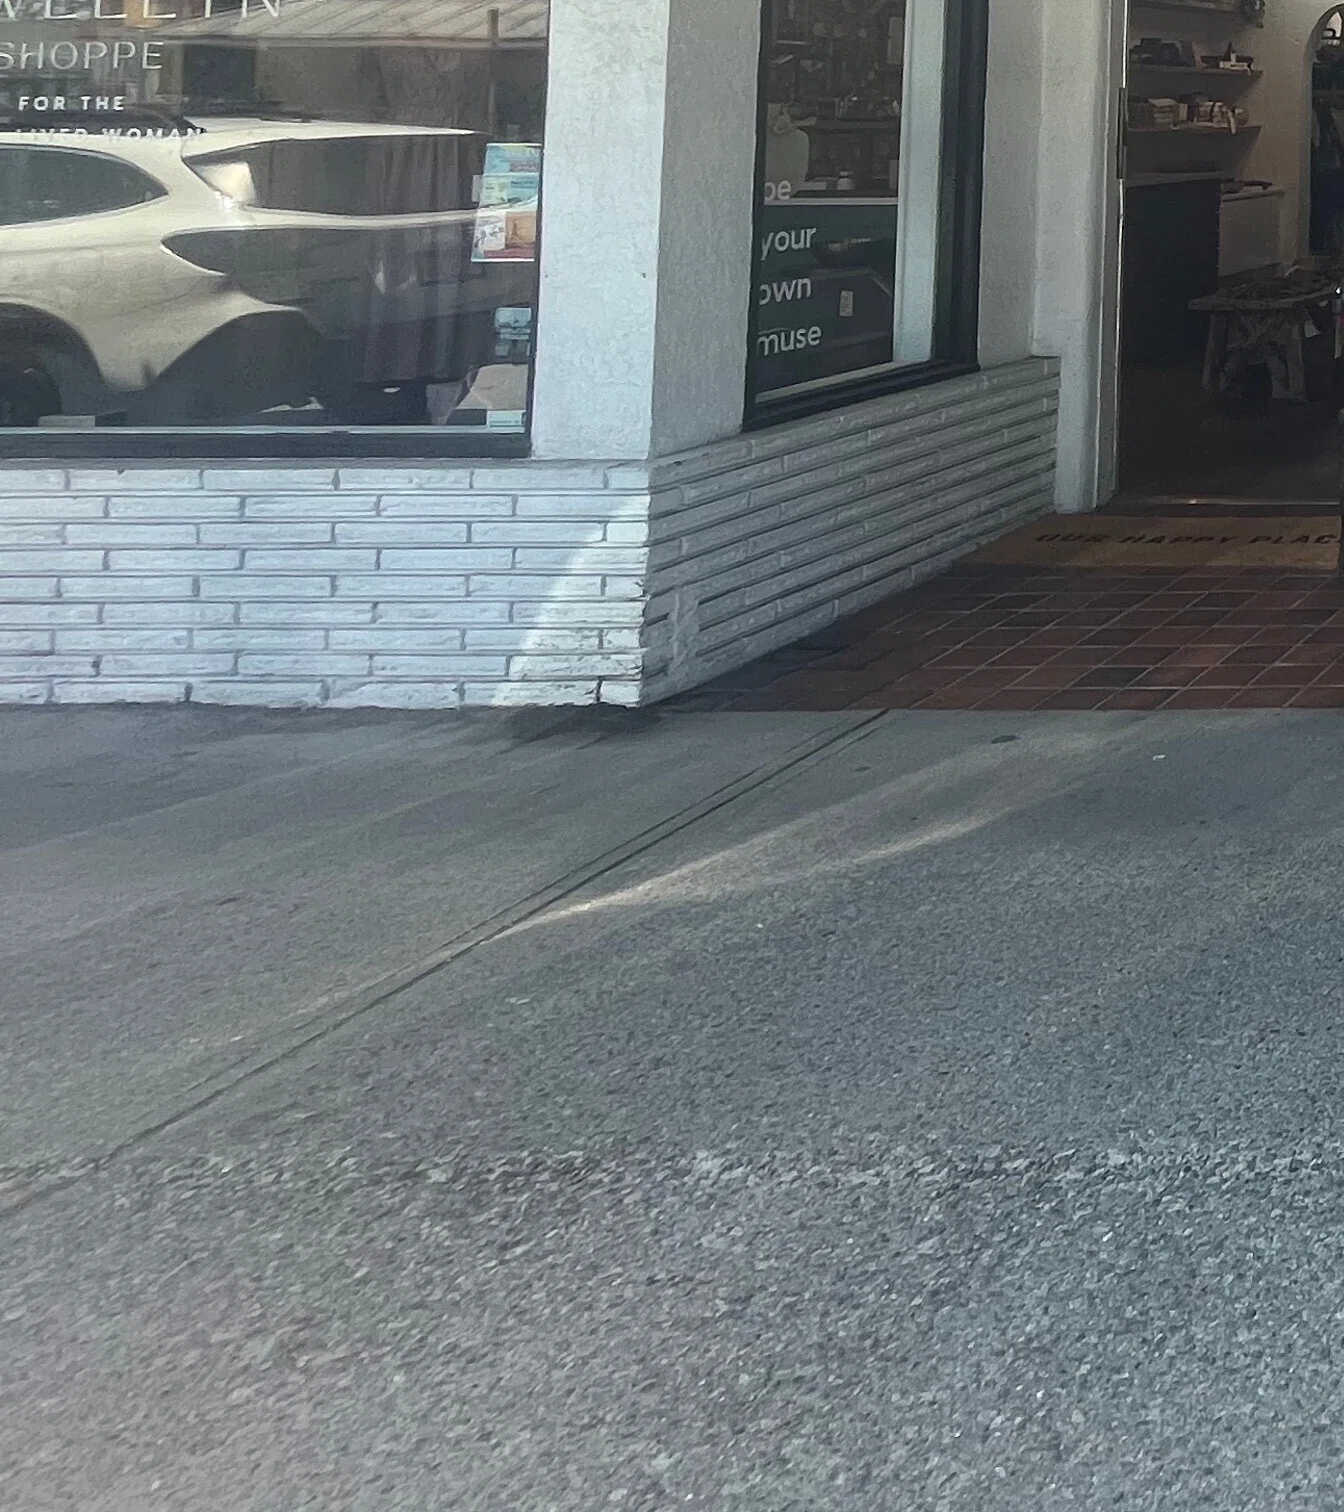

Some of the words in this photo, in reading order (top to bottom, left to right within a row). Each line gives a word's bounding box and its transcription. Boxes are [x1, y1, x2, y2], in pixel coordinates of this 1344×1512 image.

[0, 41, 165, 70] SHOPPE
[18, 96, 66, 111] FOR
[81, 96, 125, 111] THE
[760, 227, 817, 261] your
[757, 325, 822, 356] muse
